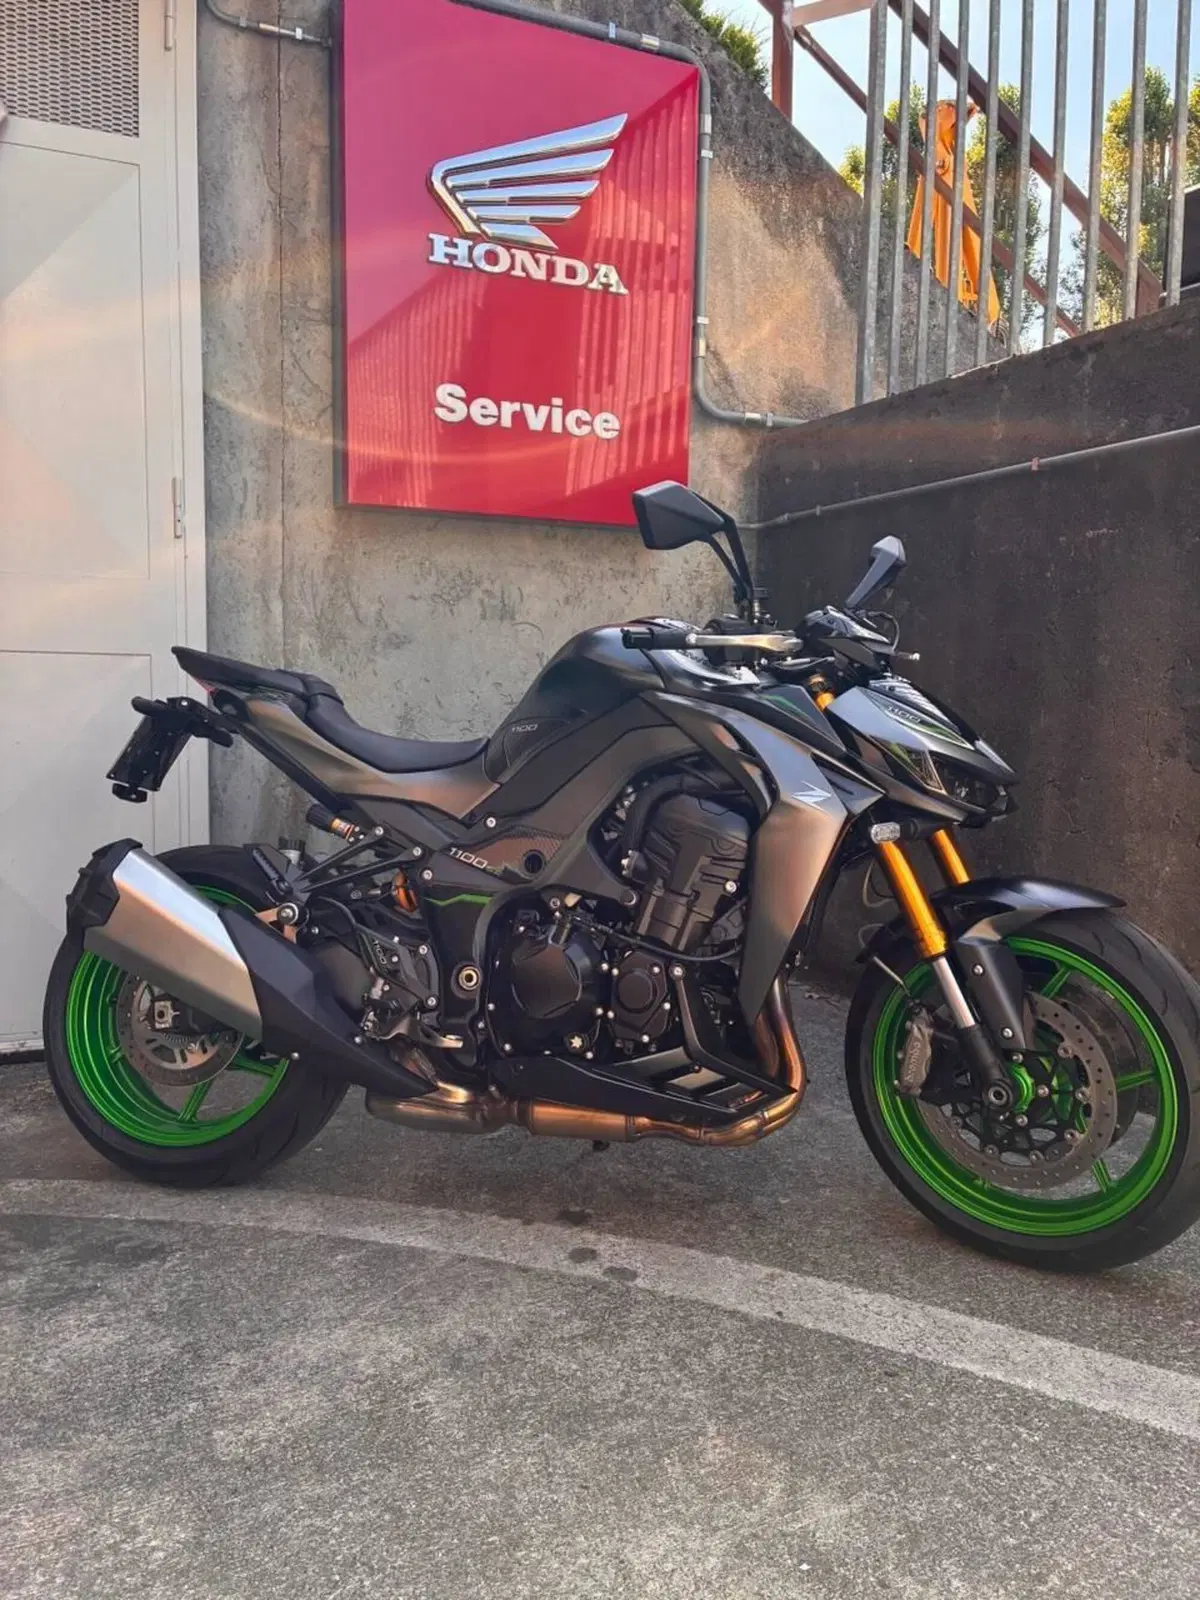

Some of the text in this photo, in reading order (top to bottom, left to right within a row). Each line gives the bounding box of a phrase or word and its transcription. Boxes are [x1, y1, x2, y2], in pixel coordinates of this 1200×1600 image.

[429, 233, 628, 294] HONDA
[434, 383, 620, 440] Service
[449, 847, 489, 869] 1100
